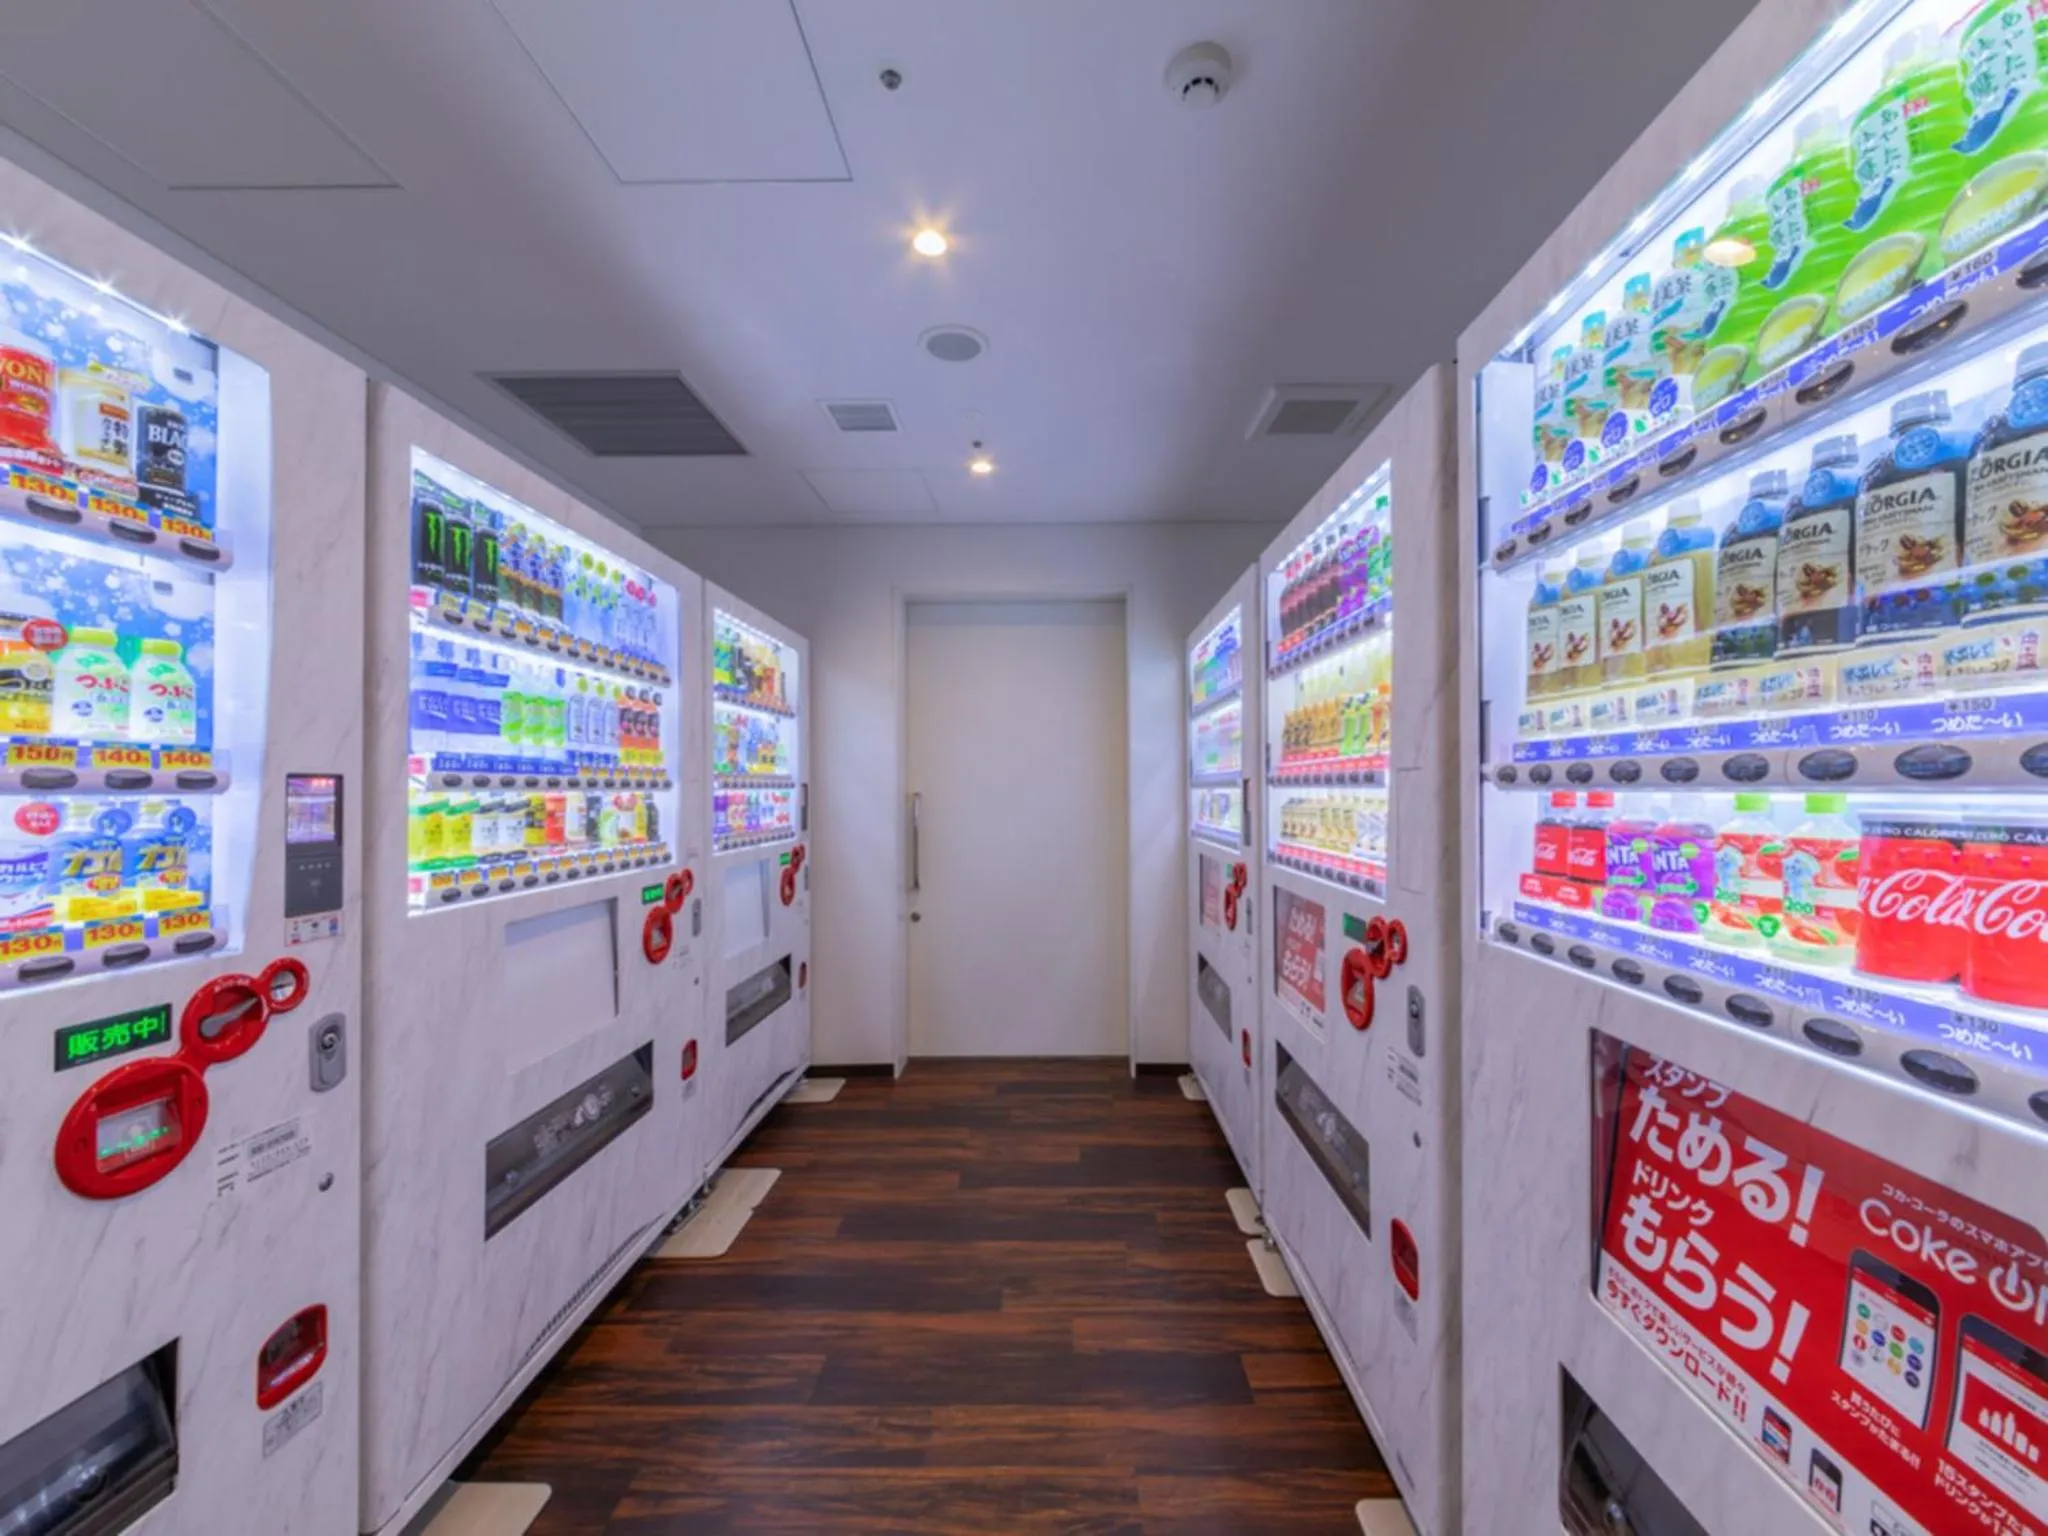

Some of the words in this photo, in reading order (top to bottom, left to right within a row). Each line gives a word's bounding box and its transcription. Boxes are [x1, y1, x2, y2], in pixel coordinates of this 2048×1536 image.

[0, 356, 50, 388] ON
[148, 424, 187, 448] BLA
[1863, 488, 1936, 516] ORGIA
[1632, 1158, 1716, 1228] ドリンク
[1859, 1198, 1979, 1285] Coke
[1881, 1182, 2048, 1277] コカ・コーラのスマホアプ
